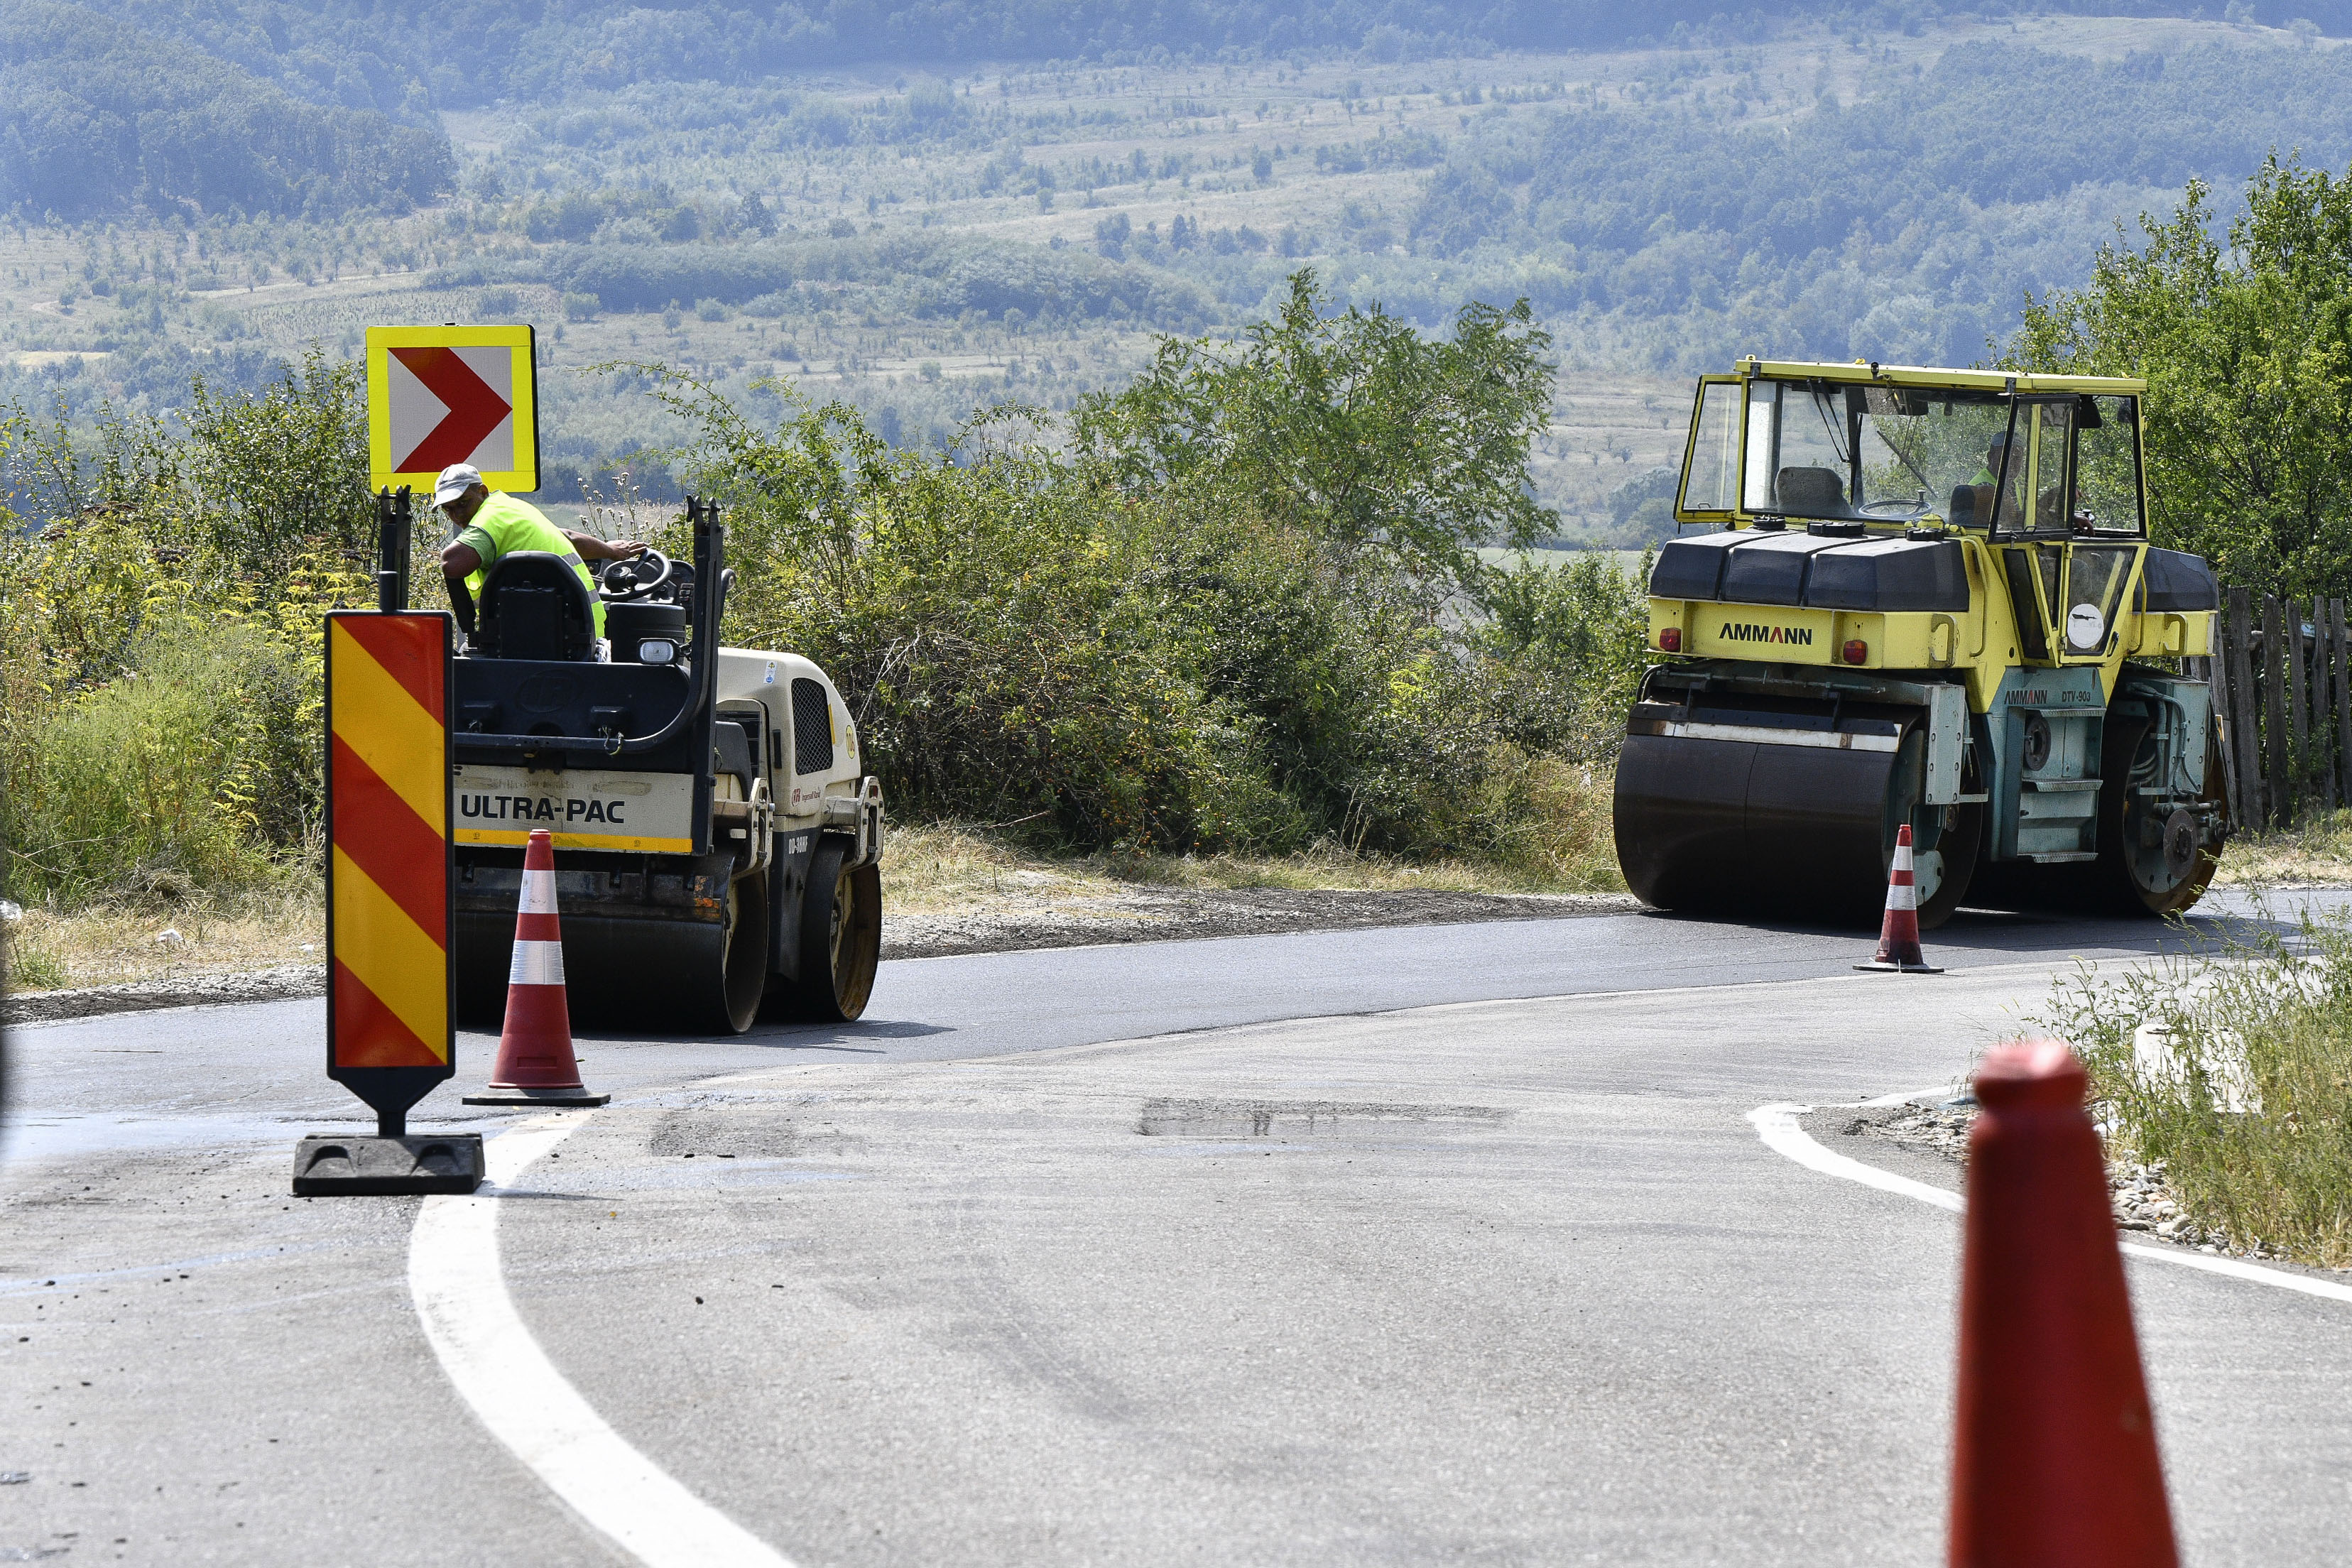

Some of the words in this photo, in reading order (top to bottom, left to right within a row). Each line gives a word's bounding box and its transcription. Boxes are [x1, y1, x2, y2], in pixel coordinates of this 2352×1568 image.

[1719, 623, 1812, 645] AMMANN
[2004, 690, 2047, 704] AMMANN
[461, 795, 625, 824] ULTRA-PAC
